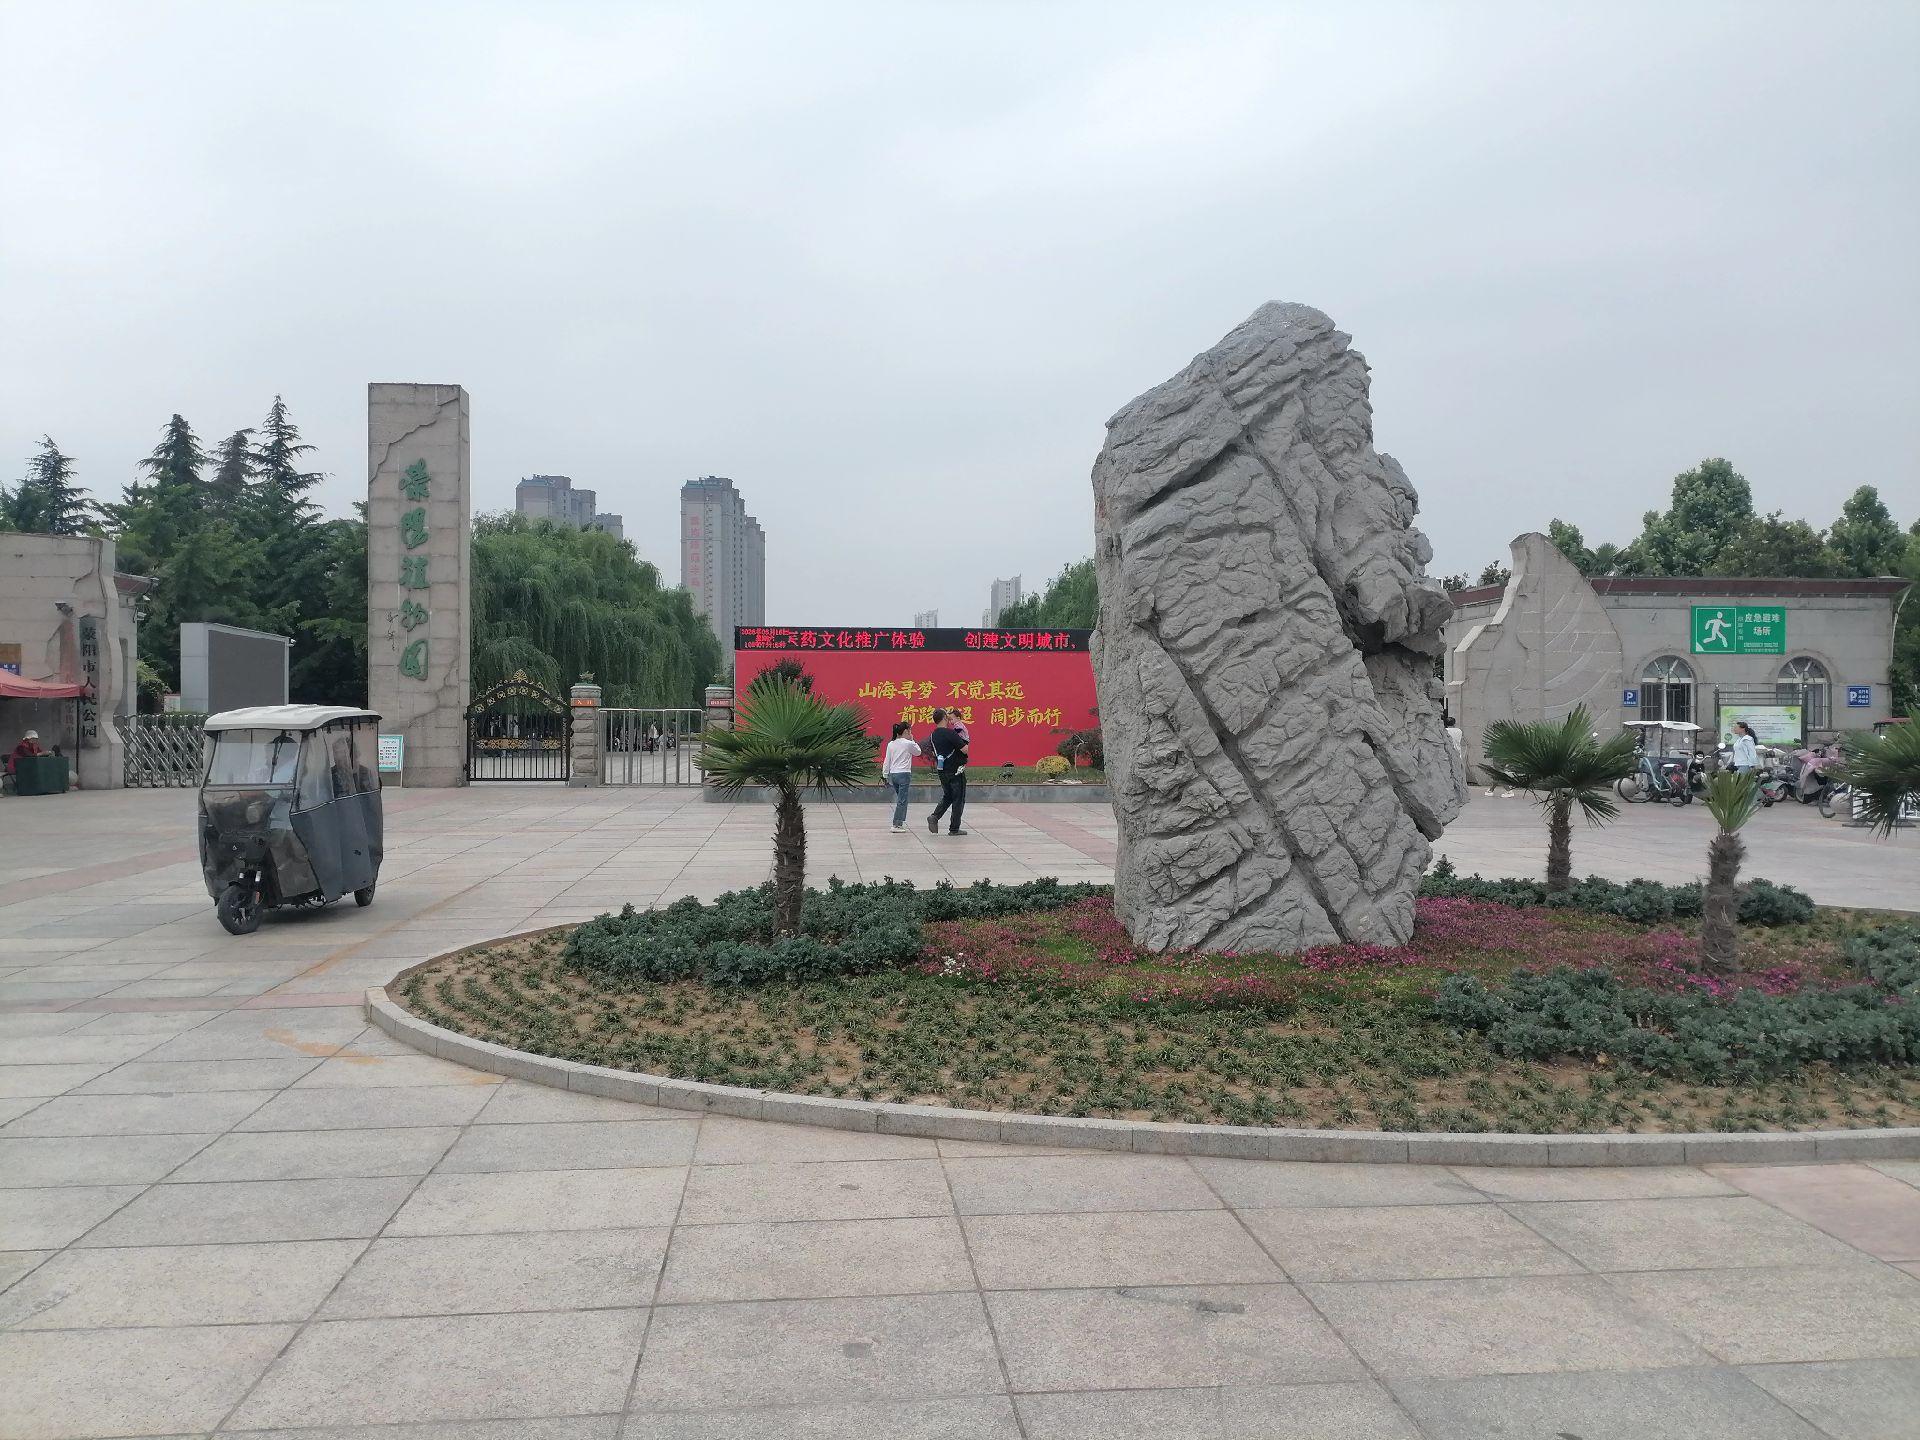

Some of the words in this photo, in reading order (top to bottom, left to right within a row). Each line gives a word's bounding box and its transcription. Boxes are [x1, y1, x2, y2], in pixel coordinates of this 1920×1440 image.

[1744, 613, 1780, 623] 应急避难
[1753, 626, 1771, 636] 场所
[858, 680, 938, 700] 山海寻梦
[946, 680, 1026, 701] 不觉其远
[897, 704, 976, 727] 前路迢
[990, 706, 1063, 727] 阔步而行
